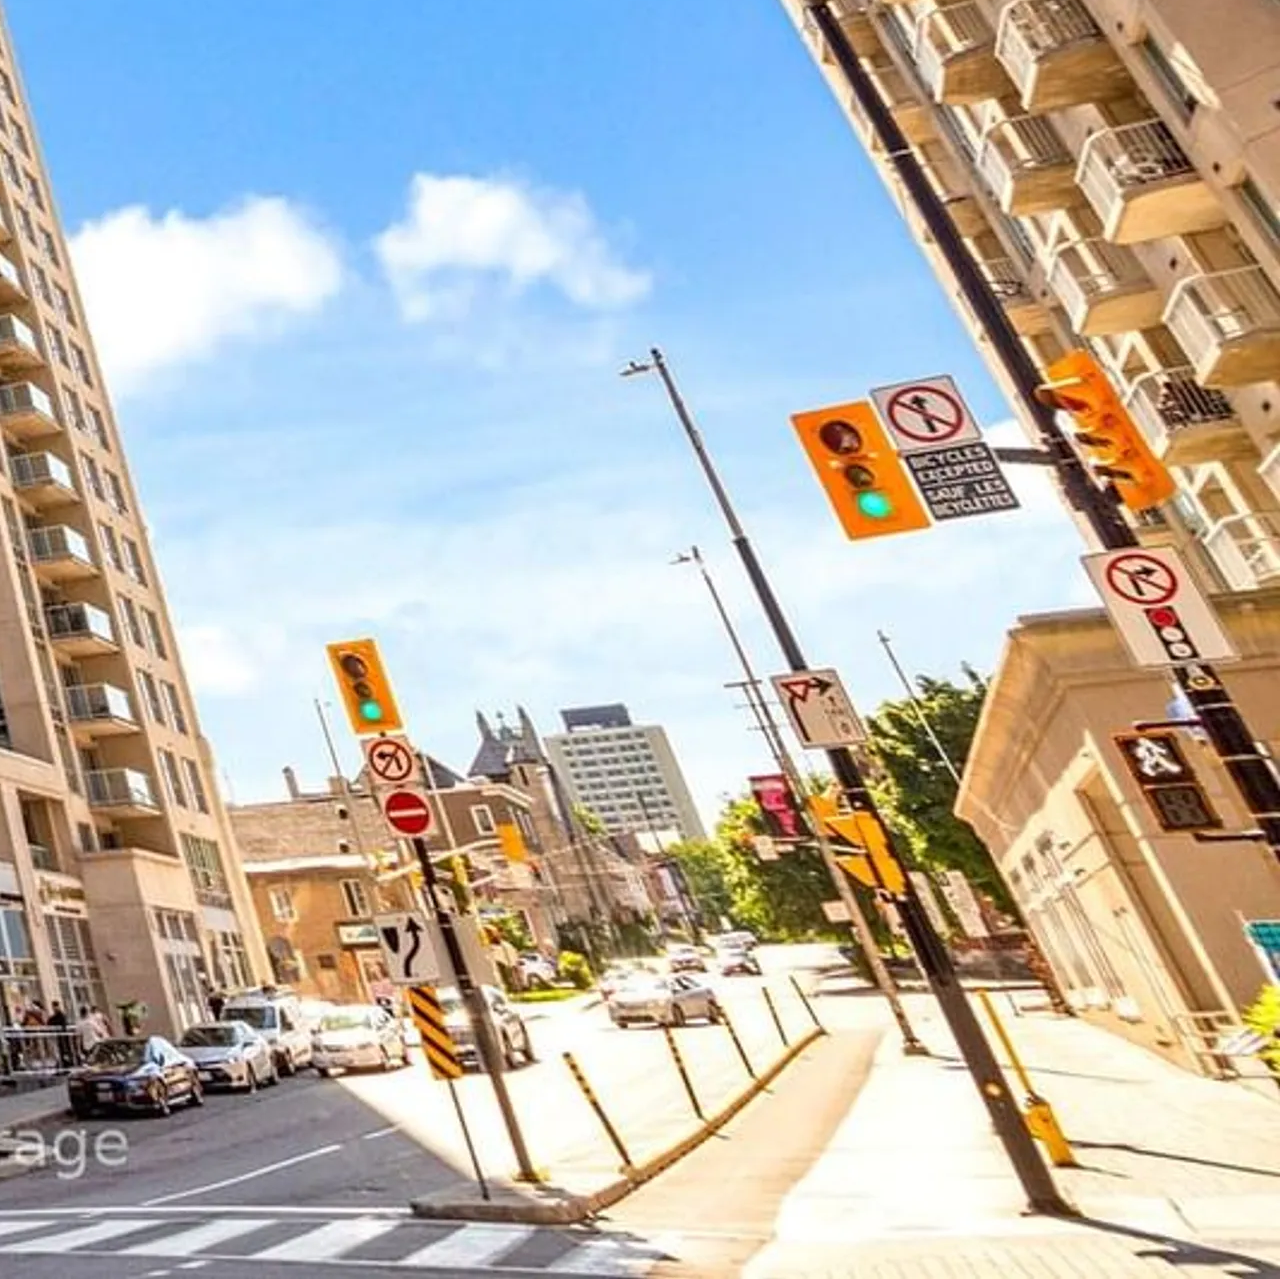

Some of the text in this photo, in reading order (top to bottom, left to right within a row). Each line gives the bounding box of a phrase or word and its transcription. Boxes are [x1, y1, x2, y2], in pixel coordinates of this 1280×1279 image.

[908, 445, 988, 469] BICYCLES
[916, 460, 995, 483] EXCEPTED
[924, 479, 1007, 502] SAUF LES
[931, 492, 1015, 517] BICYCLETTES
